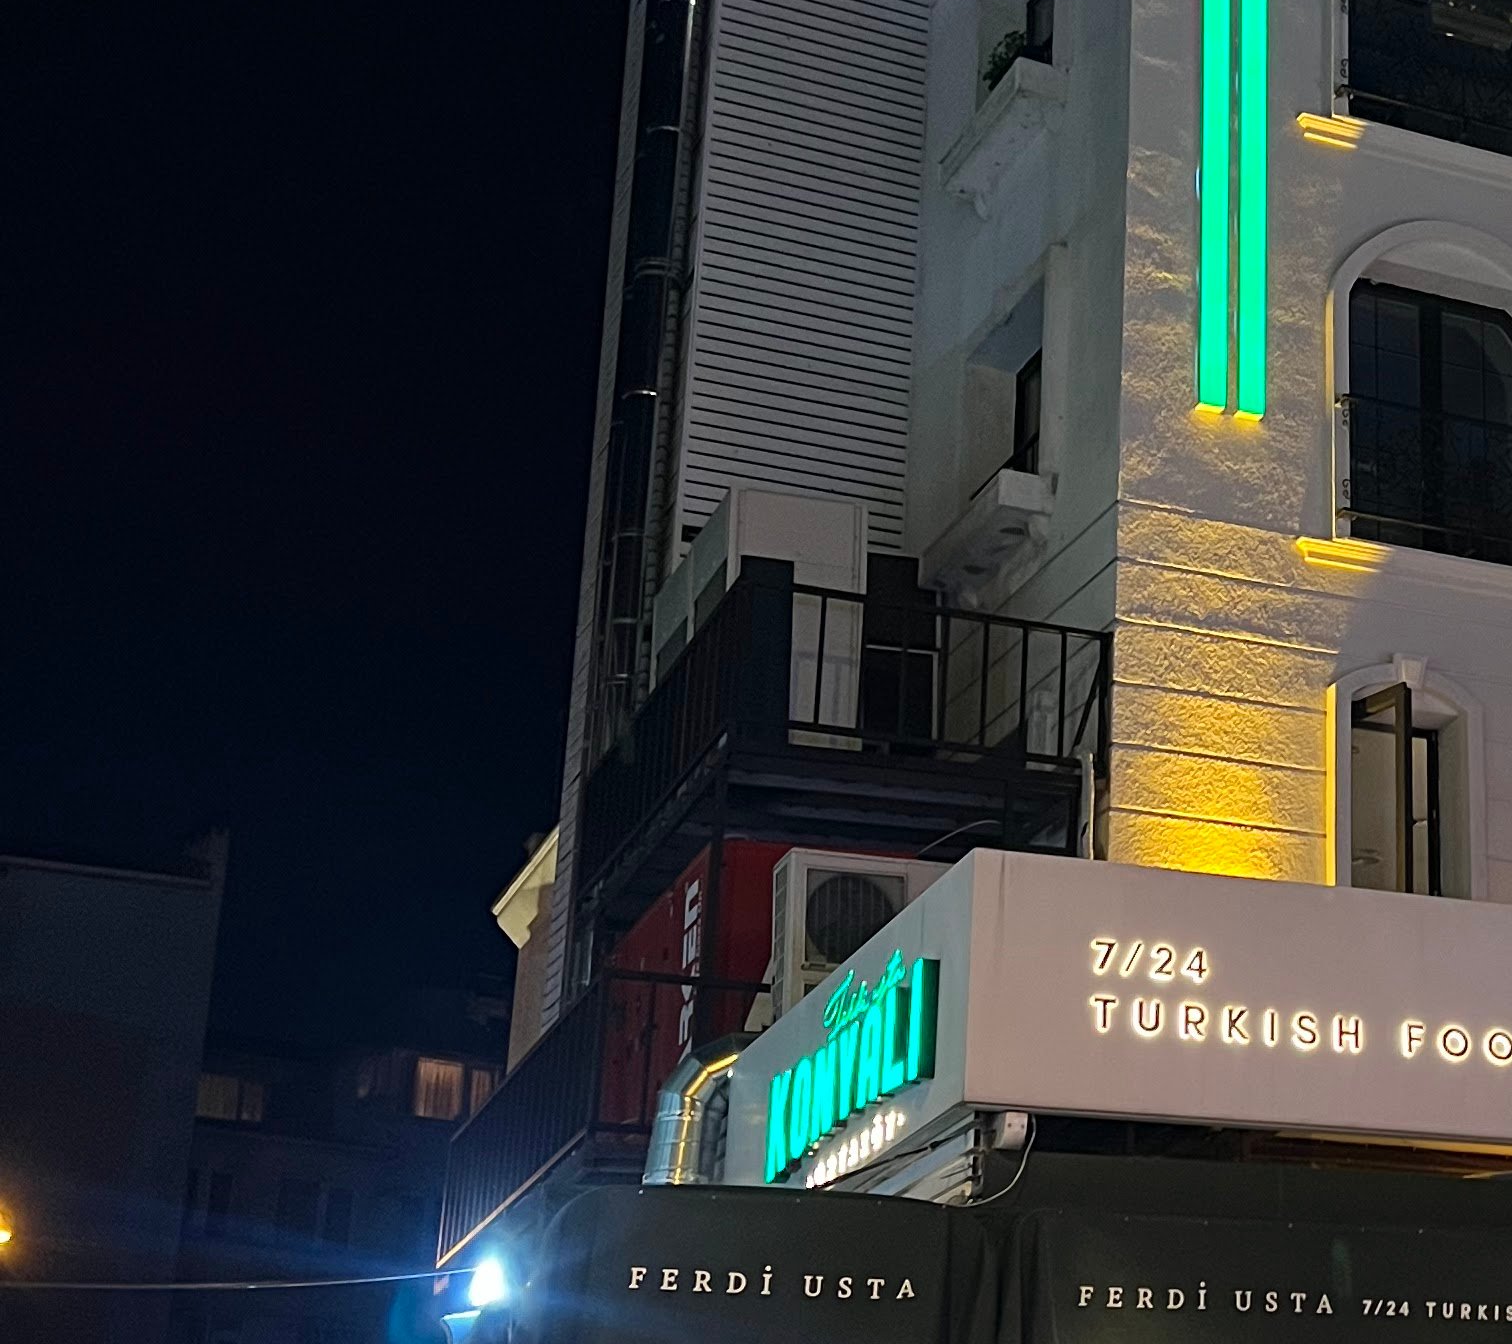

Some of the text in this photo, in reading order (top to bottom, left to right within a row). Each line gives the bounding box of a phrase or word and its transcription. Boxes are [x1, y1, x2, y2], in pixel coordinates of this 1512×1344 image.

[1090, 936, 1211, 984] 7/24
[1089, 992, 1364, 1055] TURKISH
[764, 956, 924, 1185] KONYALI
[628, 1265, 915, 1300] FERDİ USTA
[1078, 1281, 1207, 1310] FERDİ
[1234, 1290, 1333, 1314] USTA
[1362, 1299, 1410, 1317] 7/24
